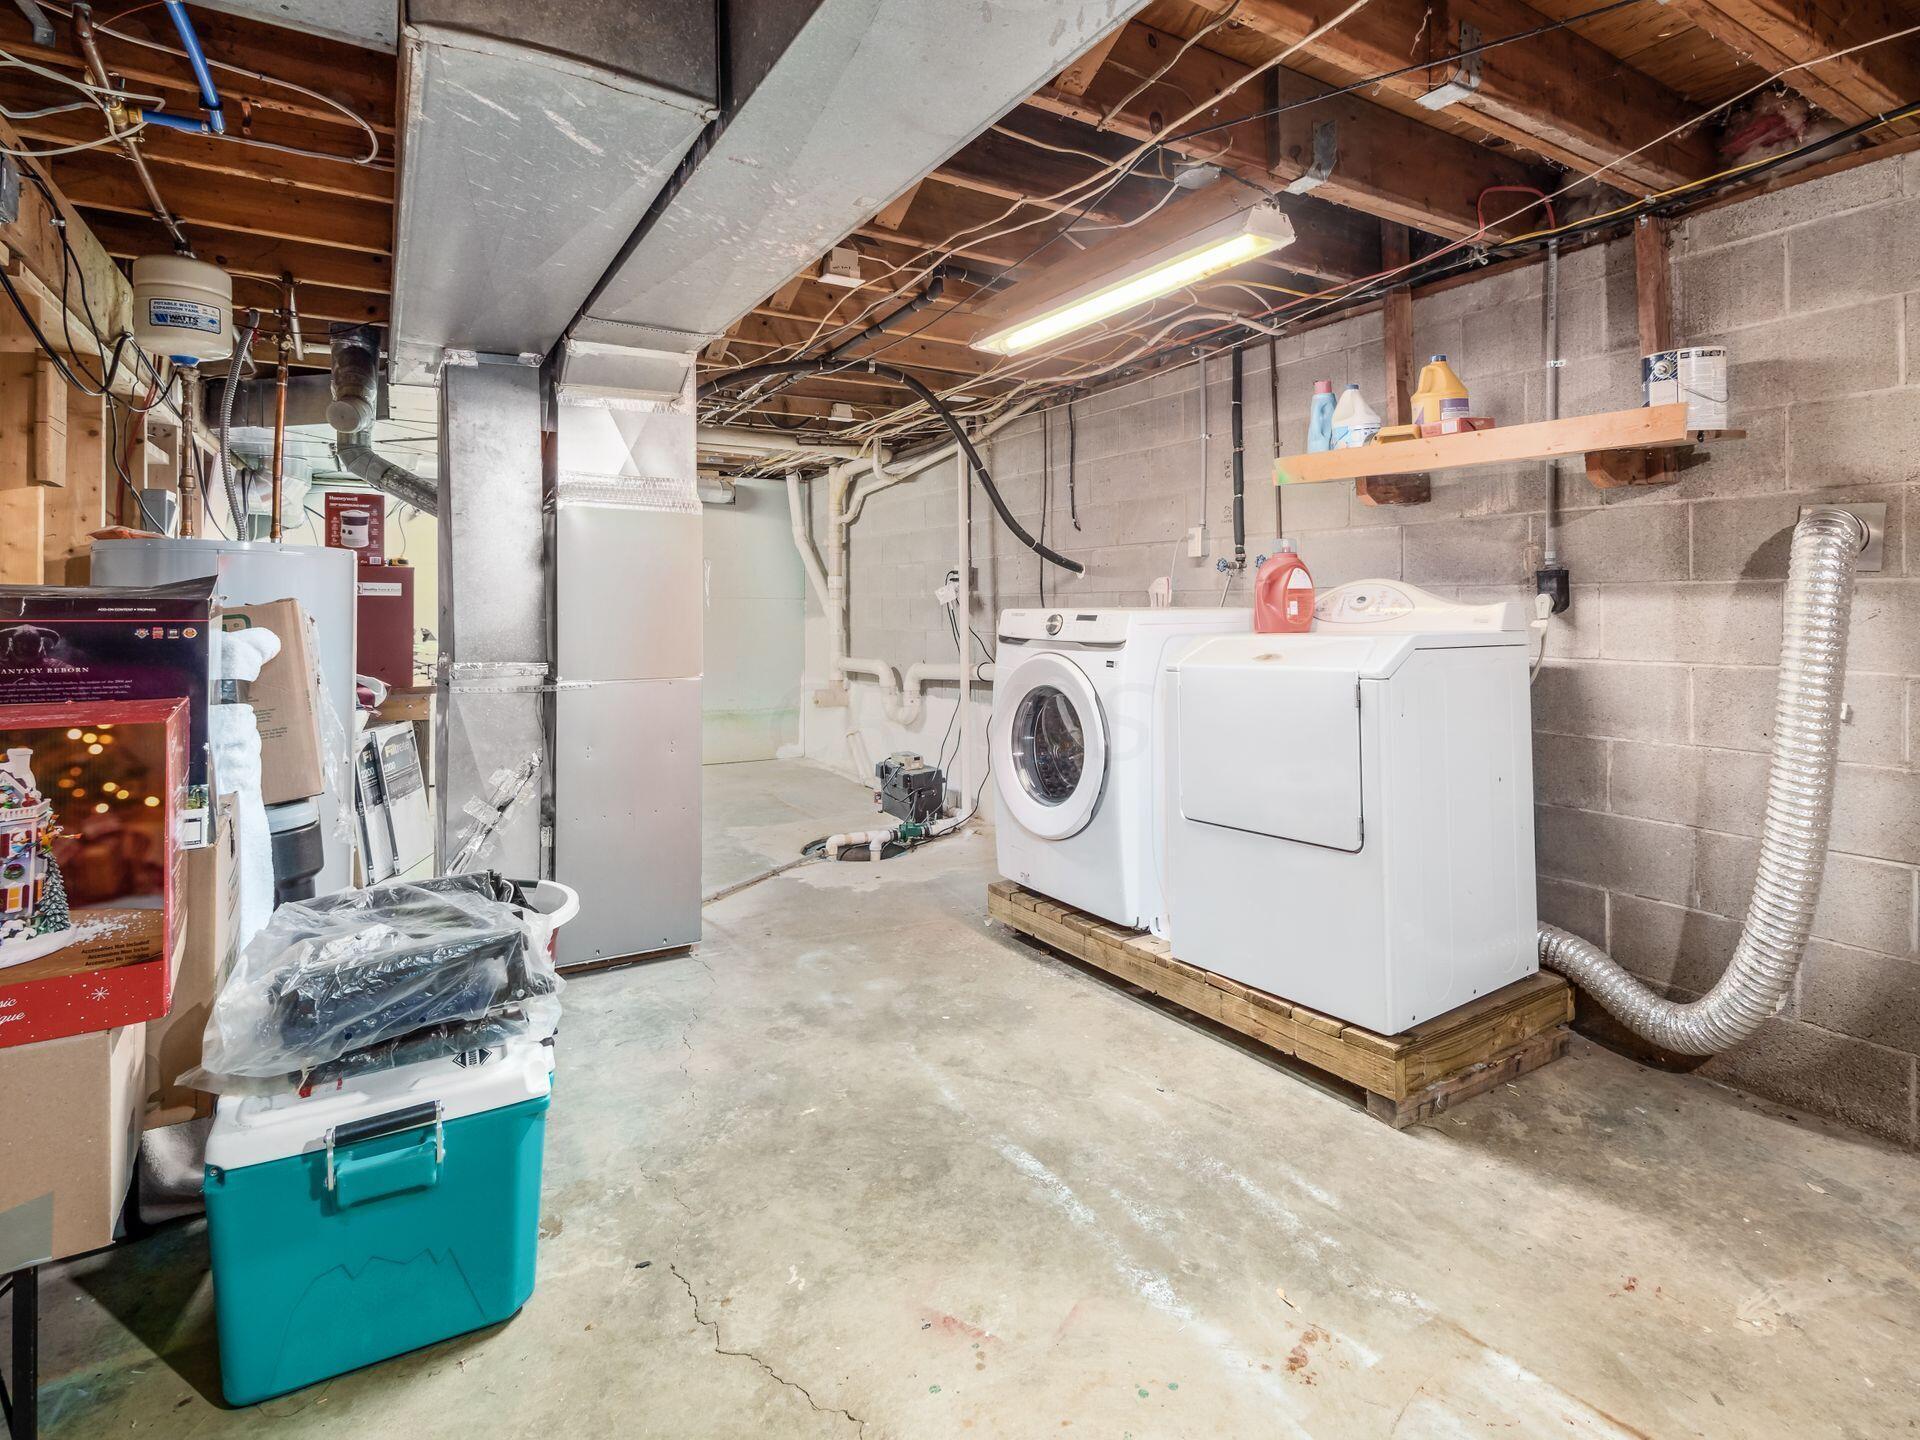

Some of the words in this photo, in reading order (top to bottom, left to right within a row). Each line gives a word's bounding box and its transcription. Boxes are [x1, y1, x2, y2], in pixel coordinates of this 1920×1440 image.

[169, 314, 200, 323] WATTS
[360, 766, 375, 778] 2200
[384, 761, 396, 773] 2200
